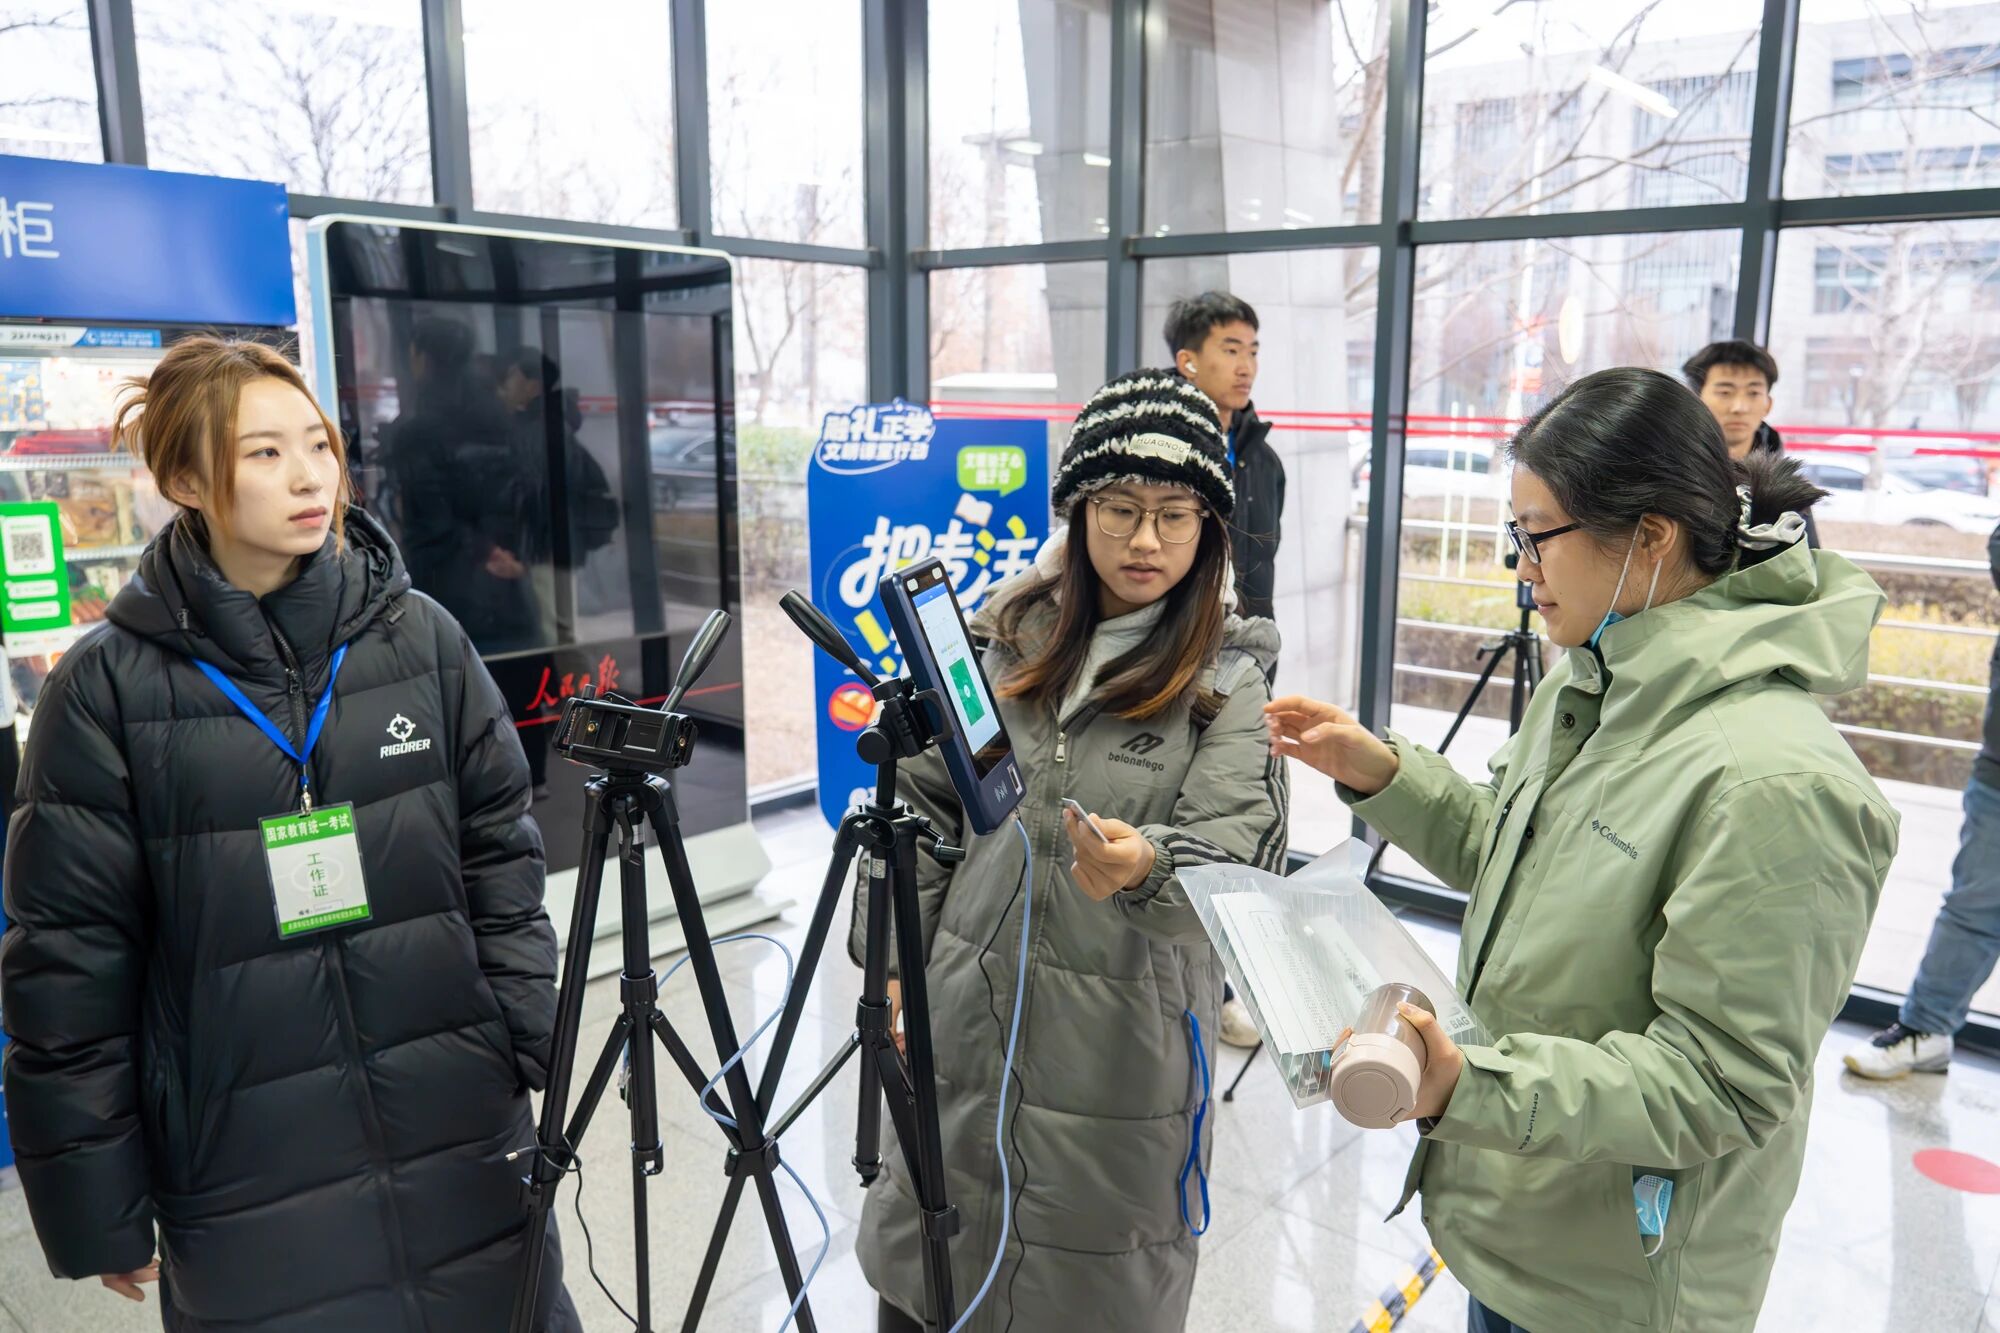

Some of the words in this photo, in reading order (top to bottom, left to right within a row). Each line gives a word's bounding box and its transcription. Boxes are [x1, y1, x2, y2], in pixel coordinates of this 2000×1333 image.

[380, 738, 431, 759] RIGORER
[265, 813, 351, 843] 国家教育统一考试
[1599, 825, 1638, 860] Columbia
[306, 852, 329, 897] 工作证
